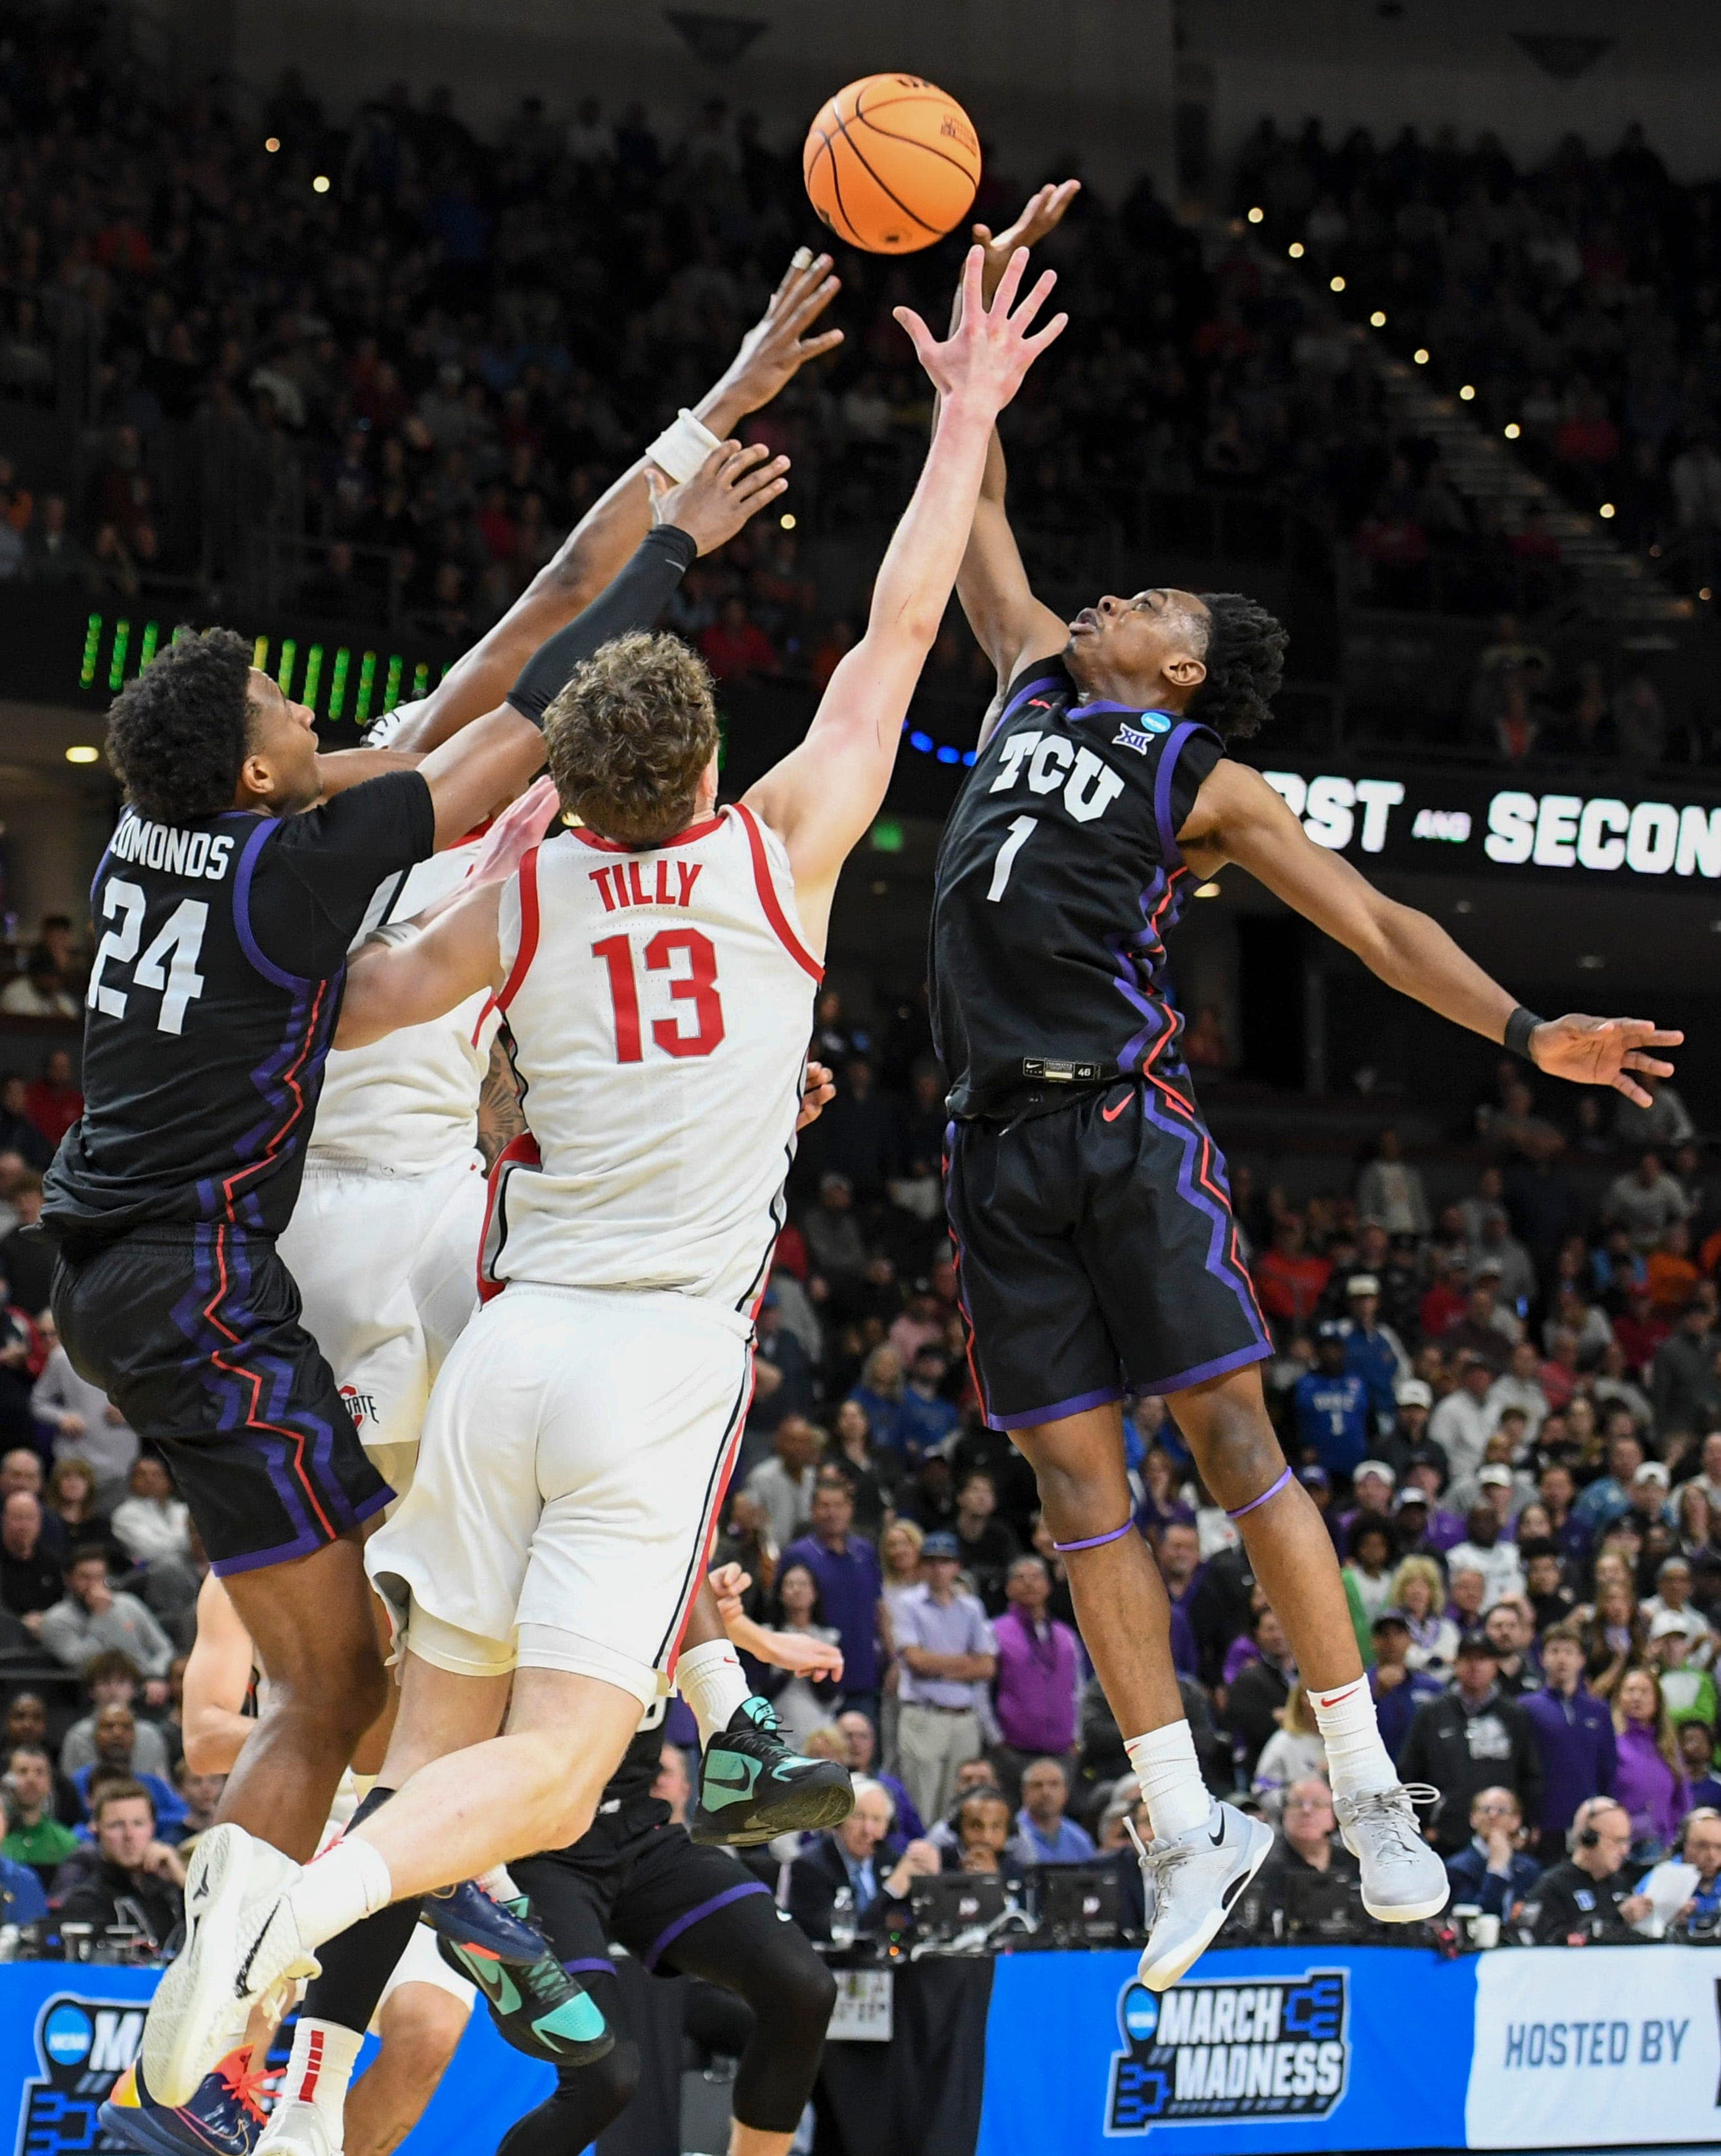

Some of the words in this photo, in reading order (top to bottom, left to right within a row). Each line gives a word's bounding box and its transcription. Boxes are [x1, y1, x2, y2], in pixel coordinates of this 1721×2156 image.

[989, 730, 1125, 822] TCU
[986, 815, 1038, 903] 1
[1484, 790, 1721, 878] SECON
[588, 860, 703, 912] TILLY
[88, 877, 209, 1035] 24
[591, 928, 726, 1064] 13
[341, 1395, 380, 1424] TATE
[1156, 1987, 1284, 2046] MARCH
[1504, 2021, 1630, 2069] HOSTED
[1640, 2017, 1691, 2063] BY
[1174, 2040, 1343, 2101] MADNESS
